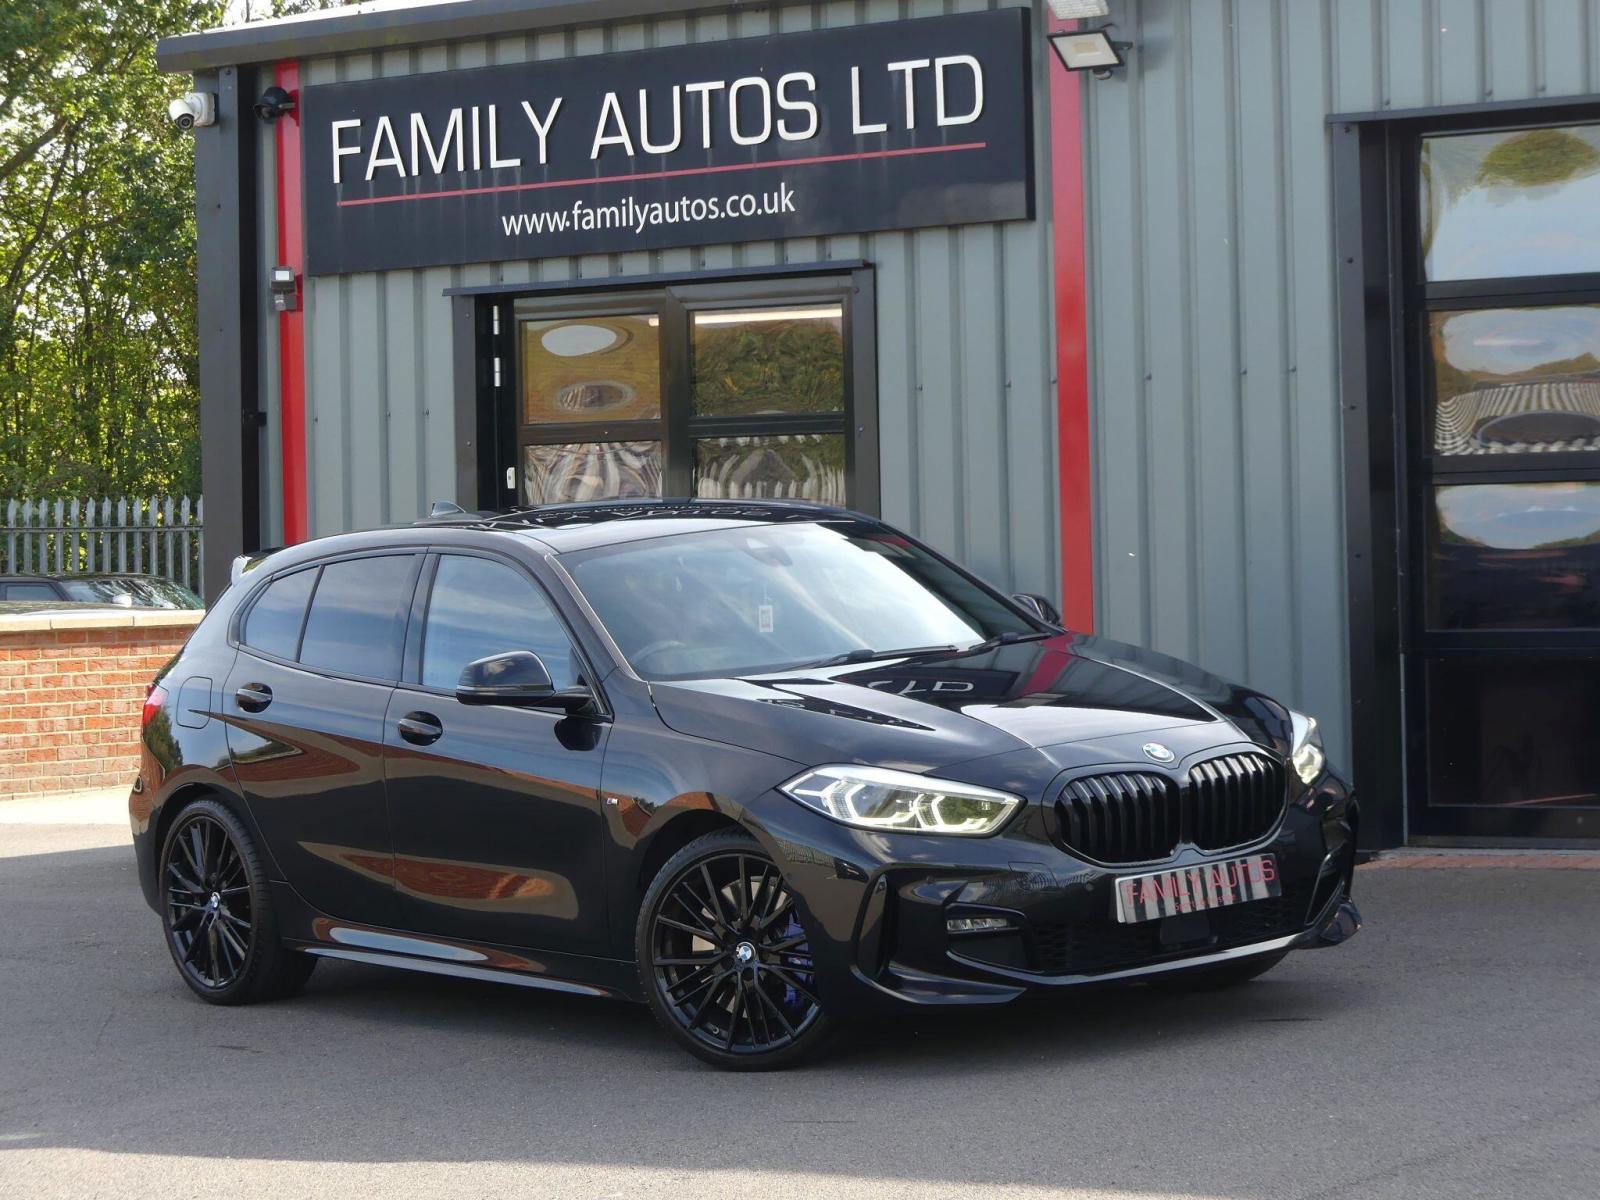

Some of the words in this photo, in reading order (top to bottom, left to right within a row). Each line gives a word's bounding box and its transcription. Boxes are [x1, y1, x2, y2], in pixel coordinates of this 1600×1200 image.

[331, 97, 563, 184] FAMILY
[591, 71, 818, 160] AUTOS
[851, 54, 984, 135] LTD
[501, 182, 796, 236] www.familyautos.co.uk
[1123, 871, 1200, 907] FAMILY
[1209, 859, 1276, 890] AUTOS
